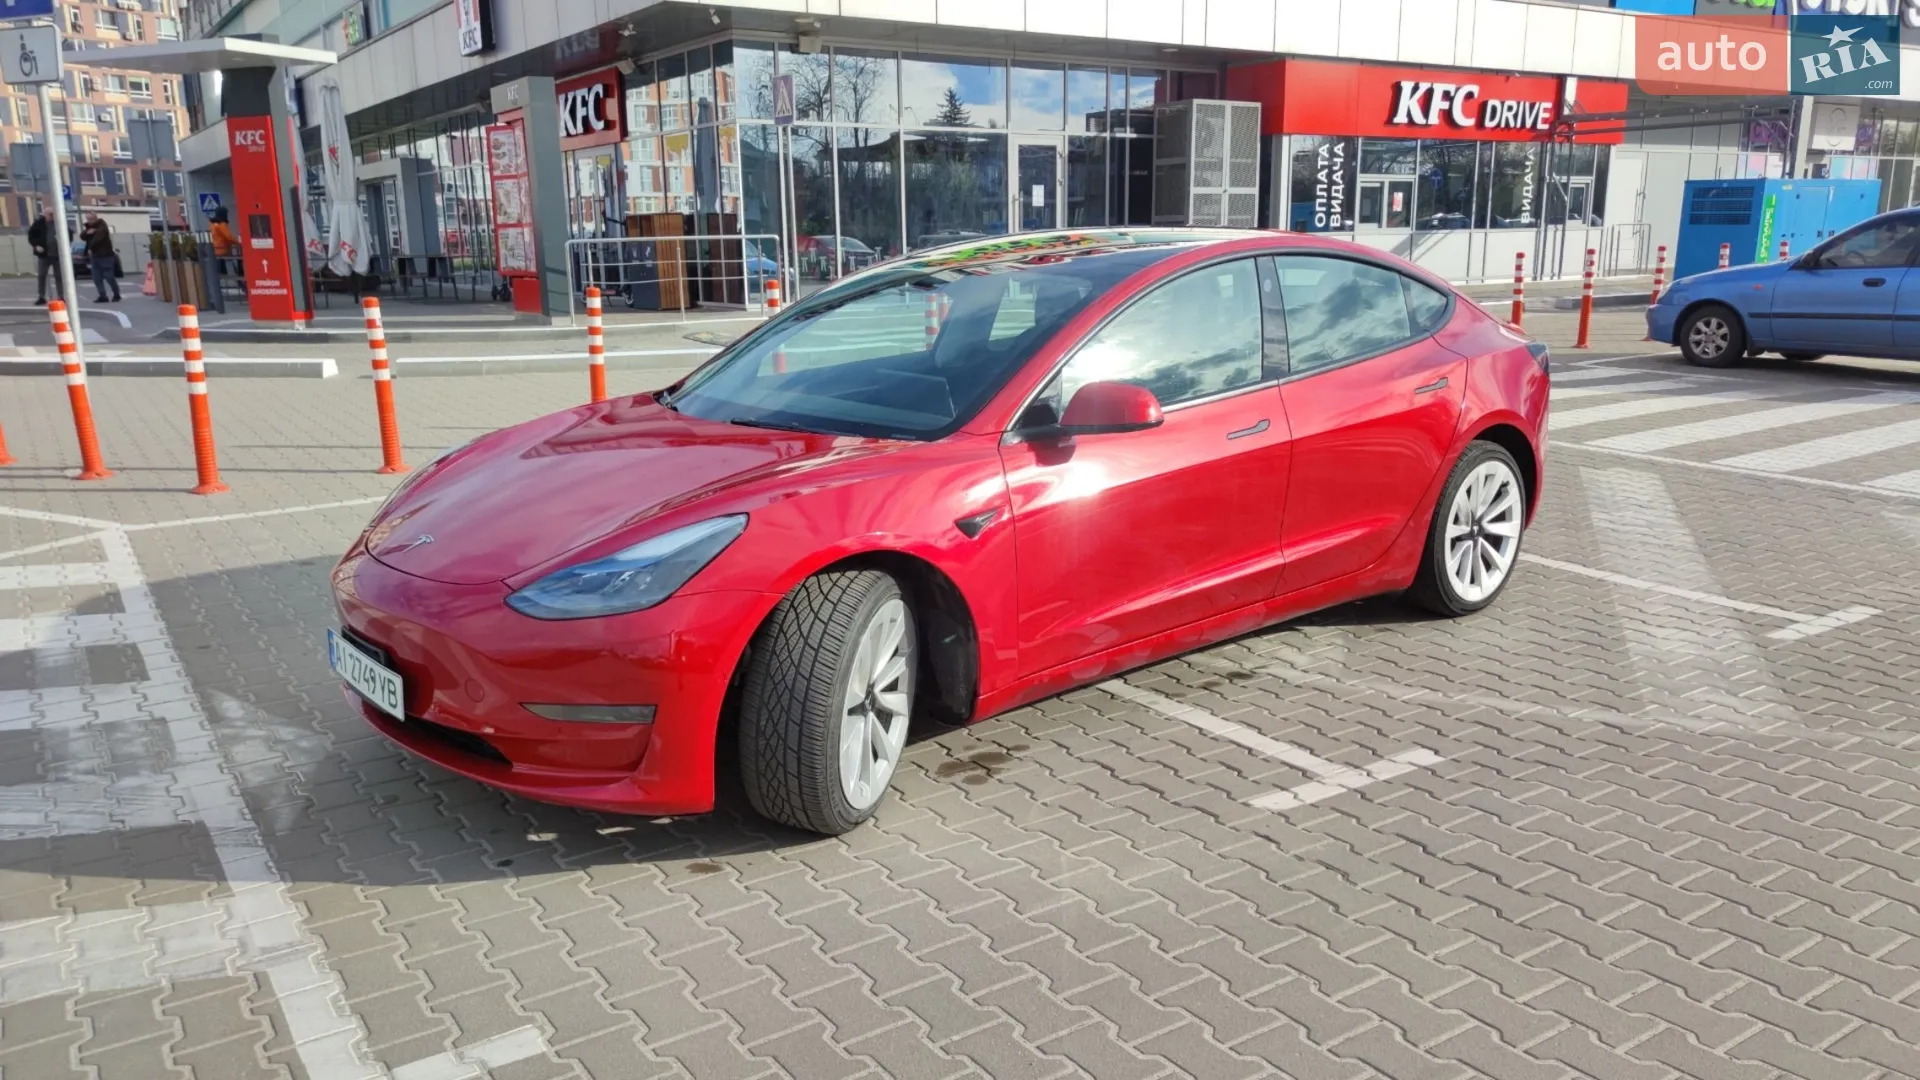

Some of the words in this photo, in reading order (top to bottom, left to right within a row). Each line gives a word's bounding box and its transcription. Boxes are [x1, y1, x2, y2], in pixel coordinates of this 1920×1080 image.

[463, 28, 478, 49] KFC
[507, 84, 519, 101] KFC
[558, 83, 606, 138] KFC
[1393, 80, 1480, 127] KFC
[1484, 99, 1553, 130] DRIVE
[235, 129, 266, 146] KFC
[1314, 143, 1330, 228] ОПЛАТА
[1330, 142, 1345, 227] ВИДАЧА
[1521, 147, 1536, 224] ВИДАЧА
[349, 652, 377, 695] 2749
